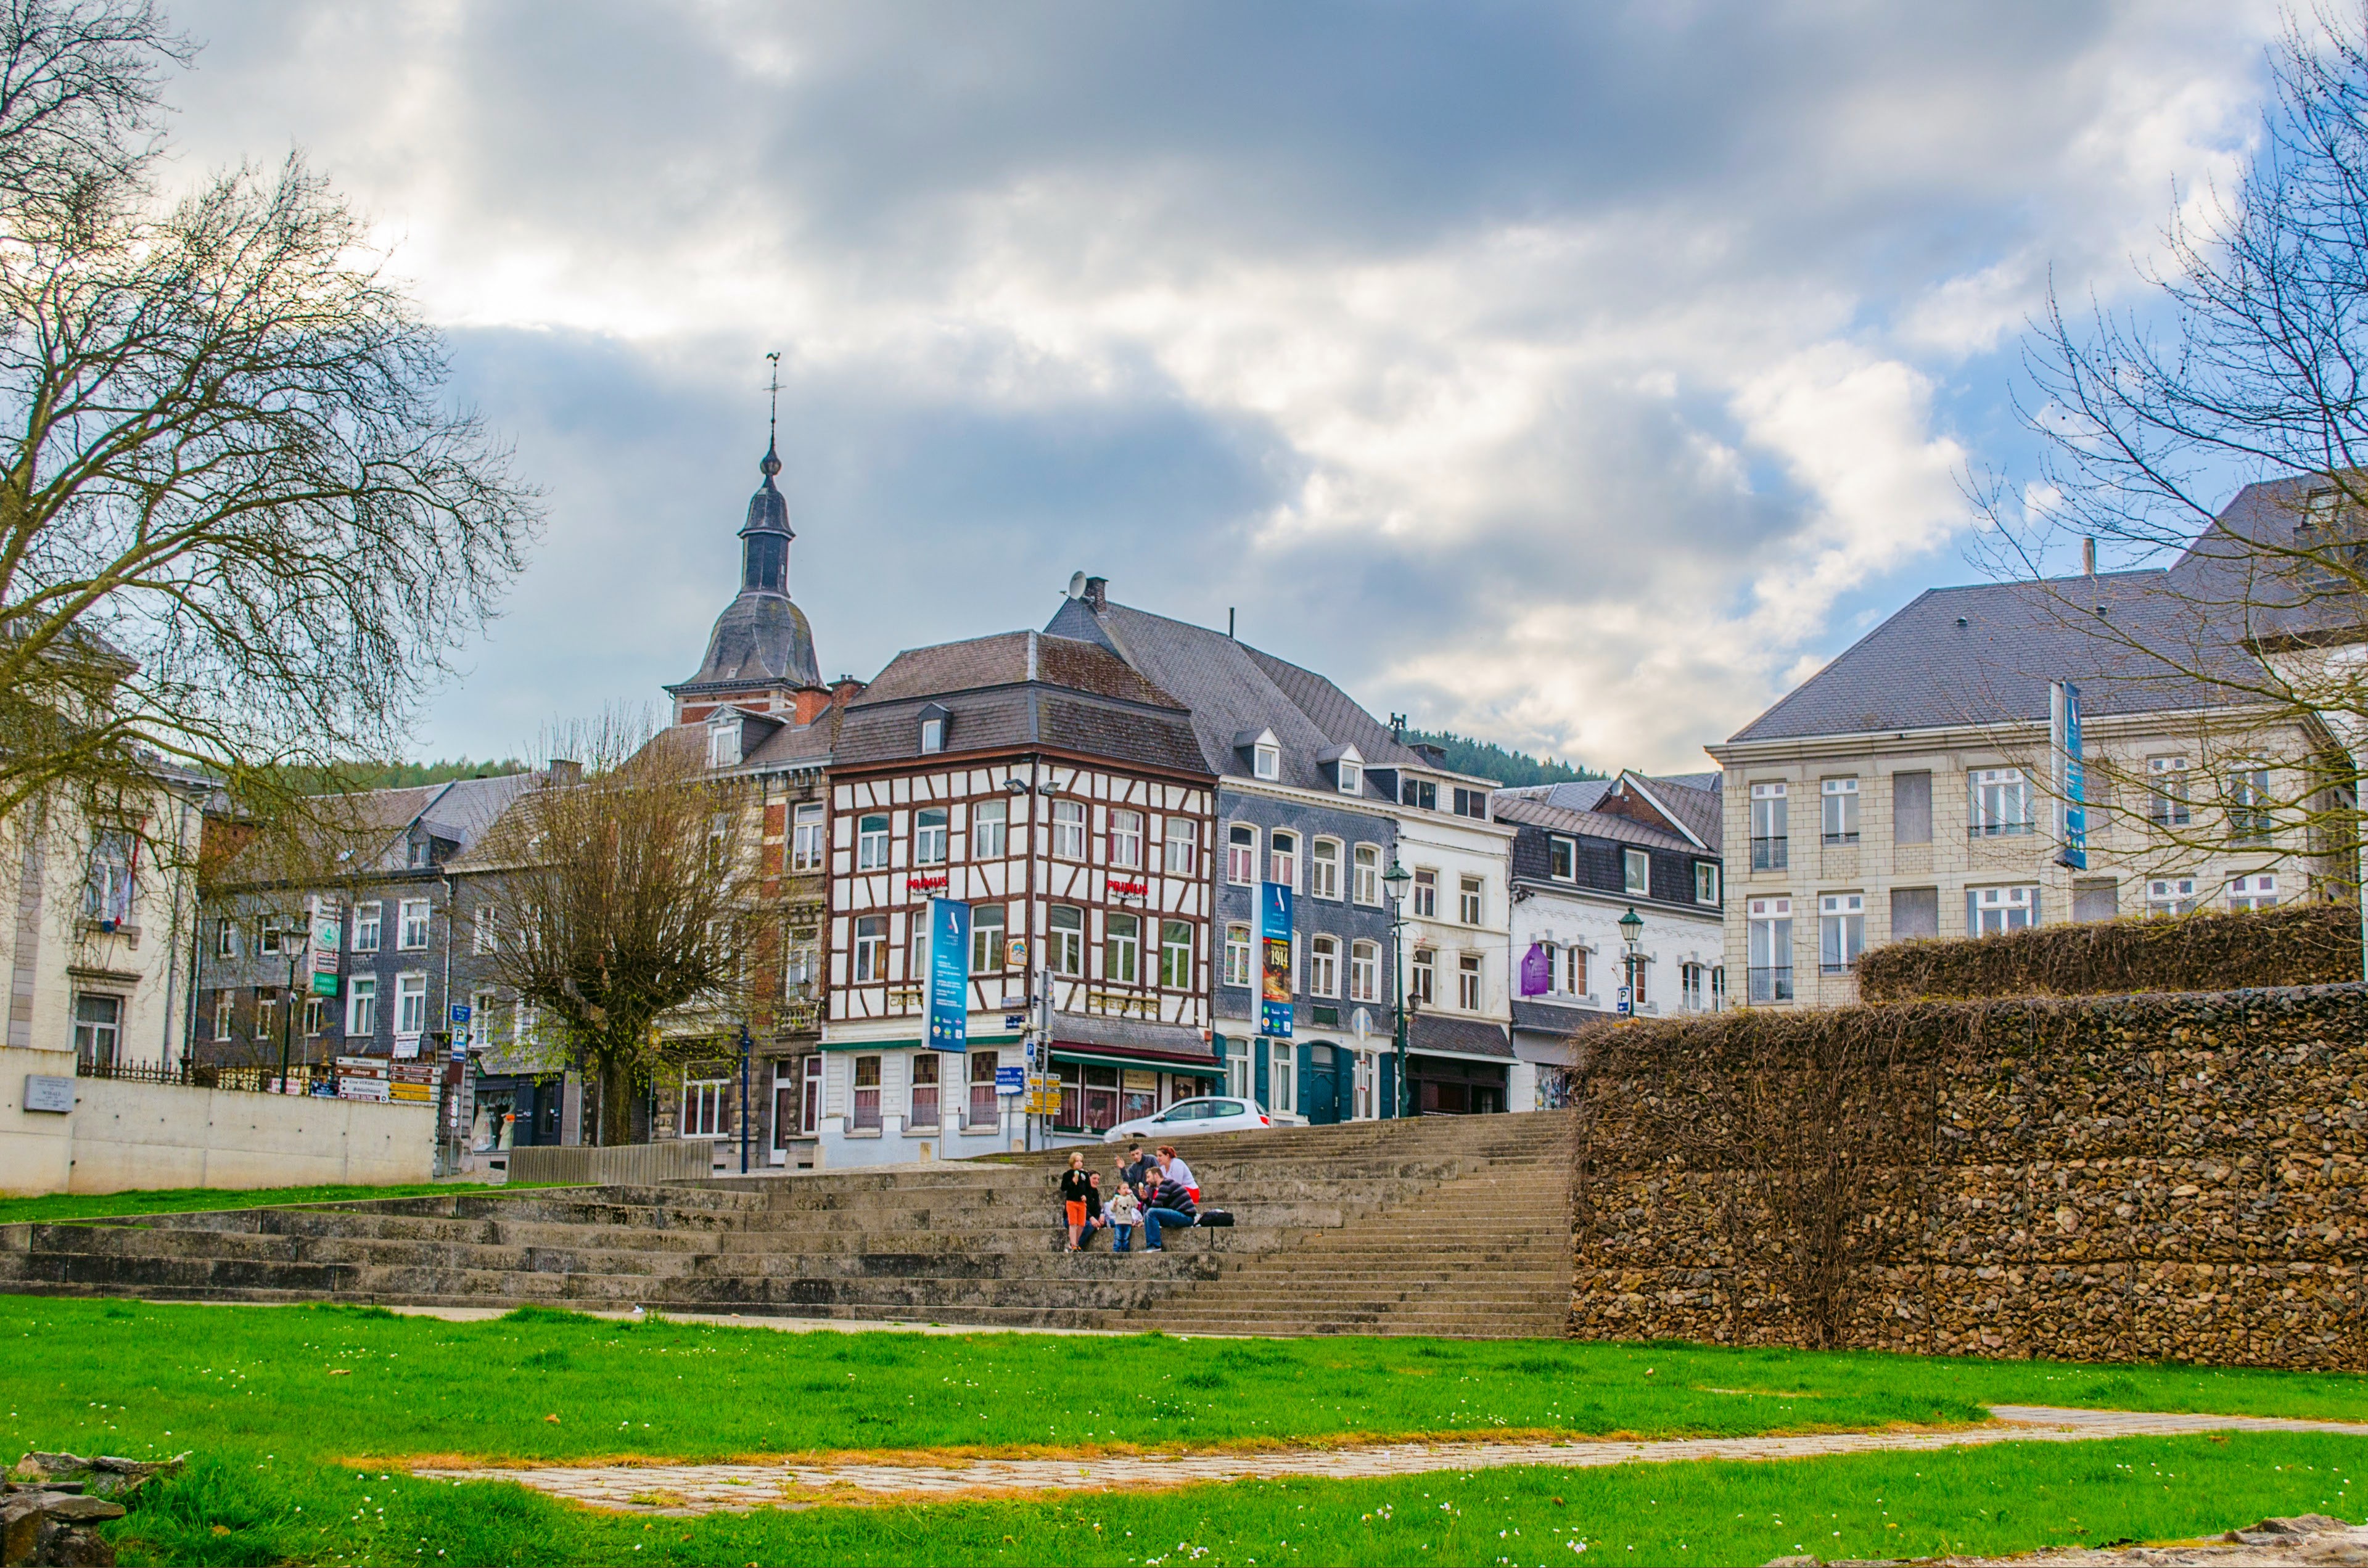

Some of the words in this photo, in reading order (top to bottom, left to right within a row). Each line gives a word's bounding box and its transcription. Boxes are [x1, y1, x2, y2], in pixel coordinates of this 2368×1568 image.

[906, 876, 947, 890] PRIMUS
[1107, 879, 1148, 896] PRIMUS
[1271, 950, 1288, 966] 1914
[1621, 991, 1627, 1002] P
[1117, 999, 1128, 1011] DU
[1133, 1002, 1158, 1014] PARC
[457, 1030, 464, 1041] P
[1029, 1045, 1034, 1054] P
